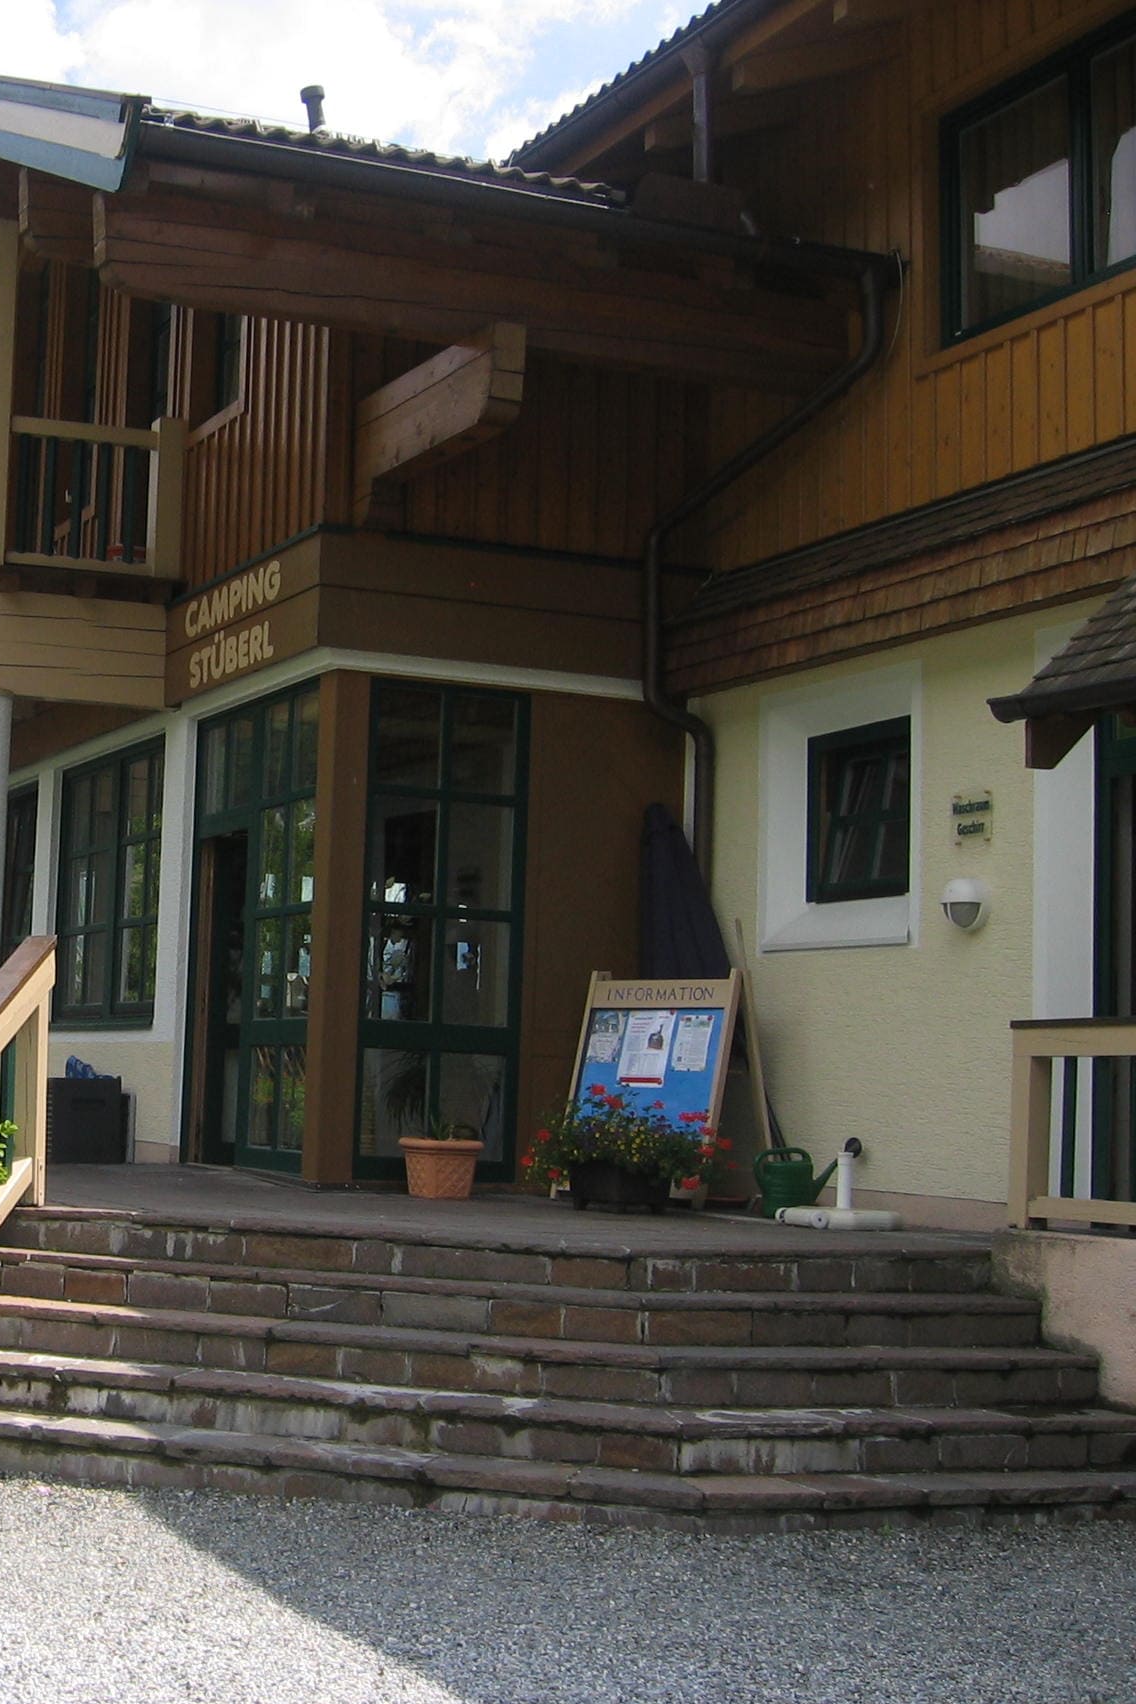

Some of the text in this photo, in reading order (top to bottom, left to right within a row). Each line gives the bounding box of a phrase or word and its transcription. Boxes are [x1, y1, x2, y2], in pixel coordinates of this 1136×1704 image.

[185, 560, 281, 638] CAMPING
[189, 621, 274, 689] STÜBERL
[607, 986, 715, 1002] INFORMATION
